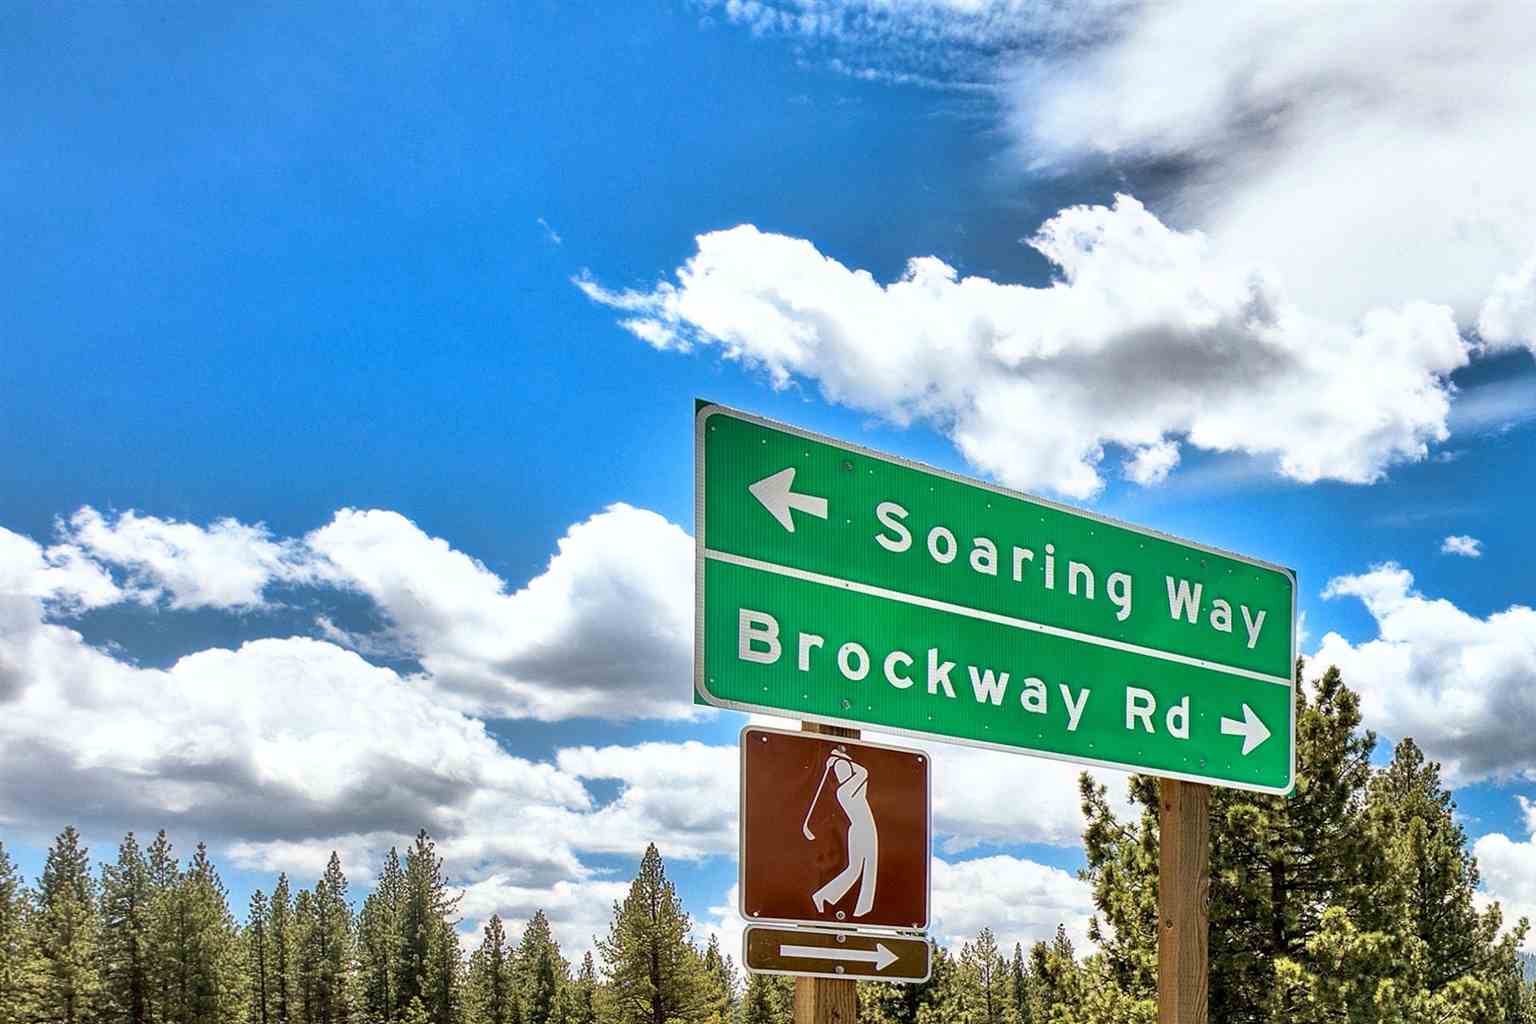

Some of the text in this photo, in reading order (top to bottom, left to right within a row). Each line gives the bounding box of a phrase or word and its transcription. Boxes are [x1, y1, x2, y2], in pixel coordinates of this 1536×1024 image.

[874, 501, 1266, 649] Soaring Way
[738, 607, 1190, 740] Brockway Rd
